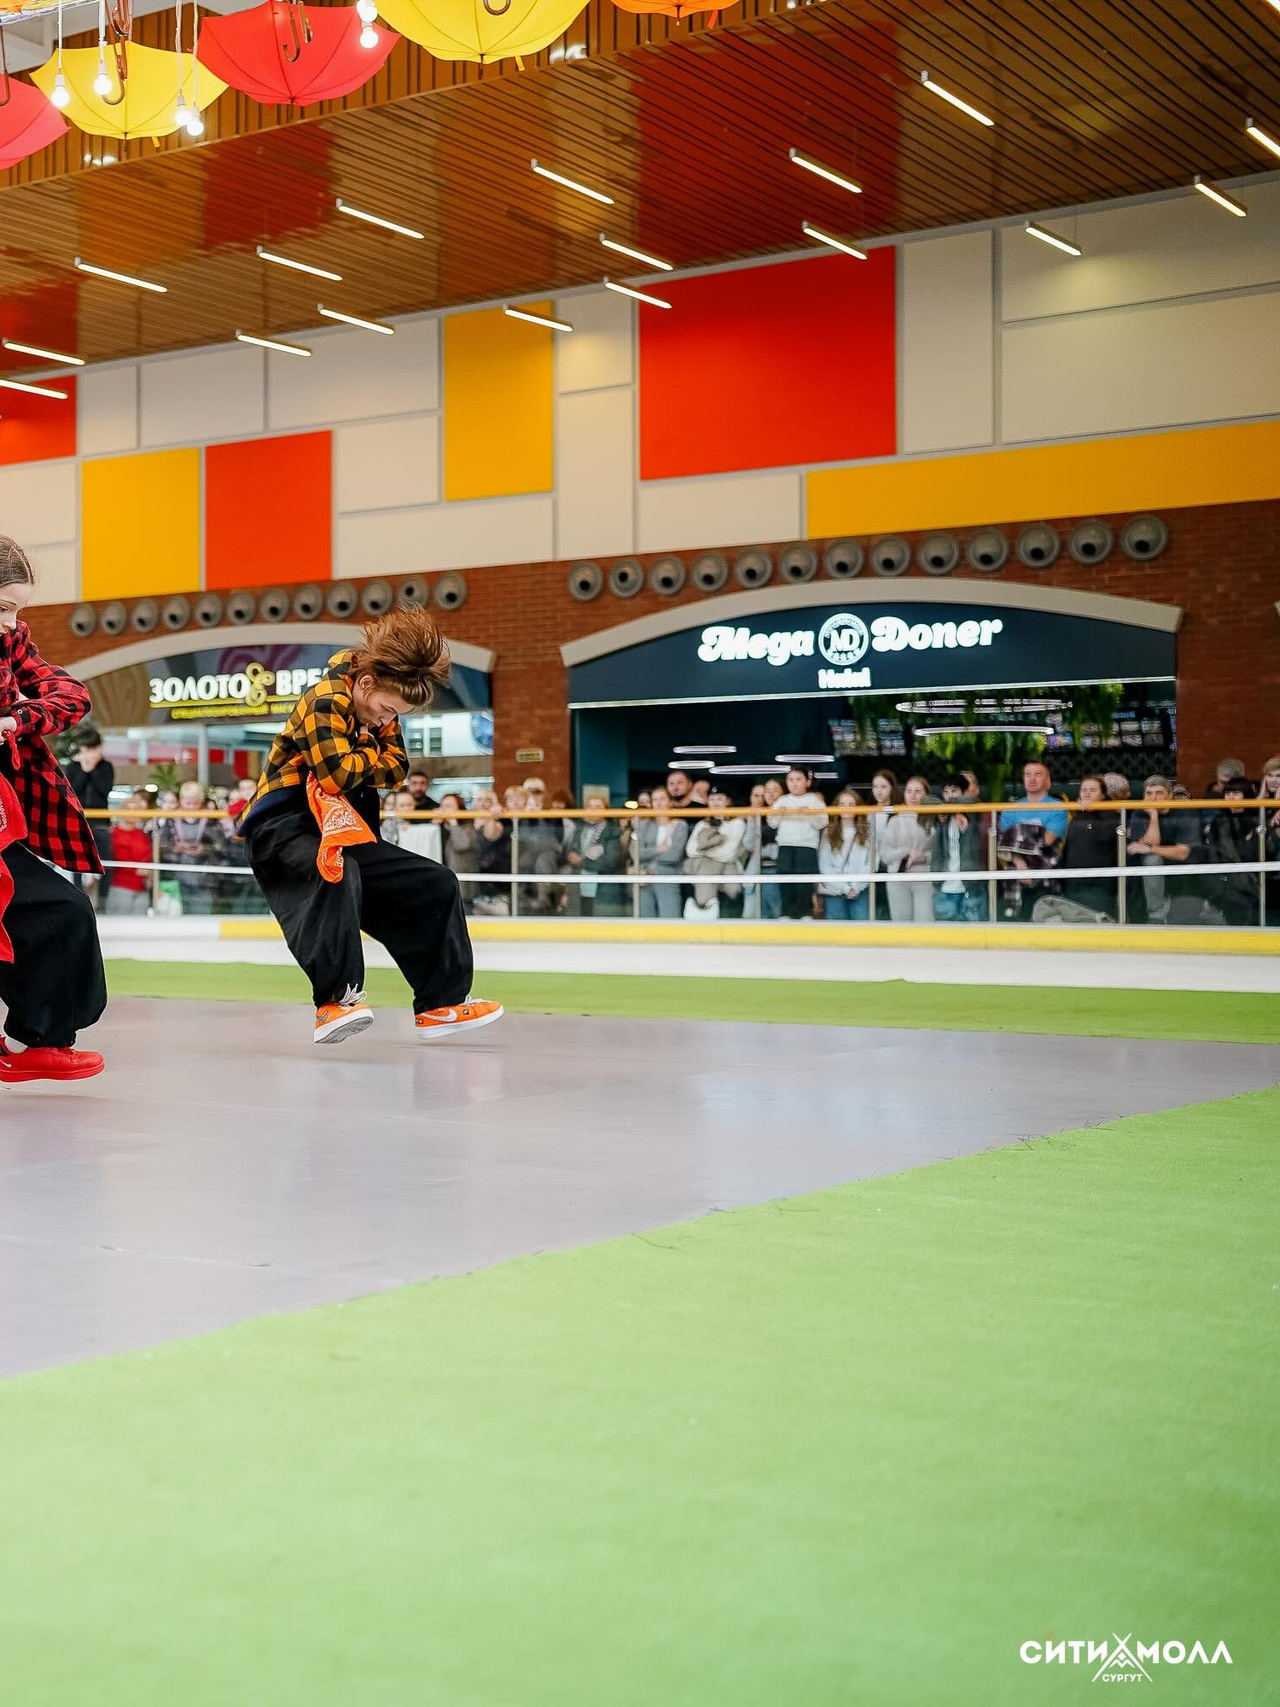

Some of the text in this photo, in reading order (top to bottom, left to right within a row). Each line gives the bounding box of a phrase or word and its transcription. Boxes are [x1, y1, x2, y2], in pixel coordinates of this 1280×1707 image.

[870, 616, 1003, 651] Doner
[149, 673, 251, 703] ЗОЛОТО
[276, 668, 329, 695] ВРЕ
